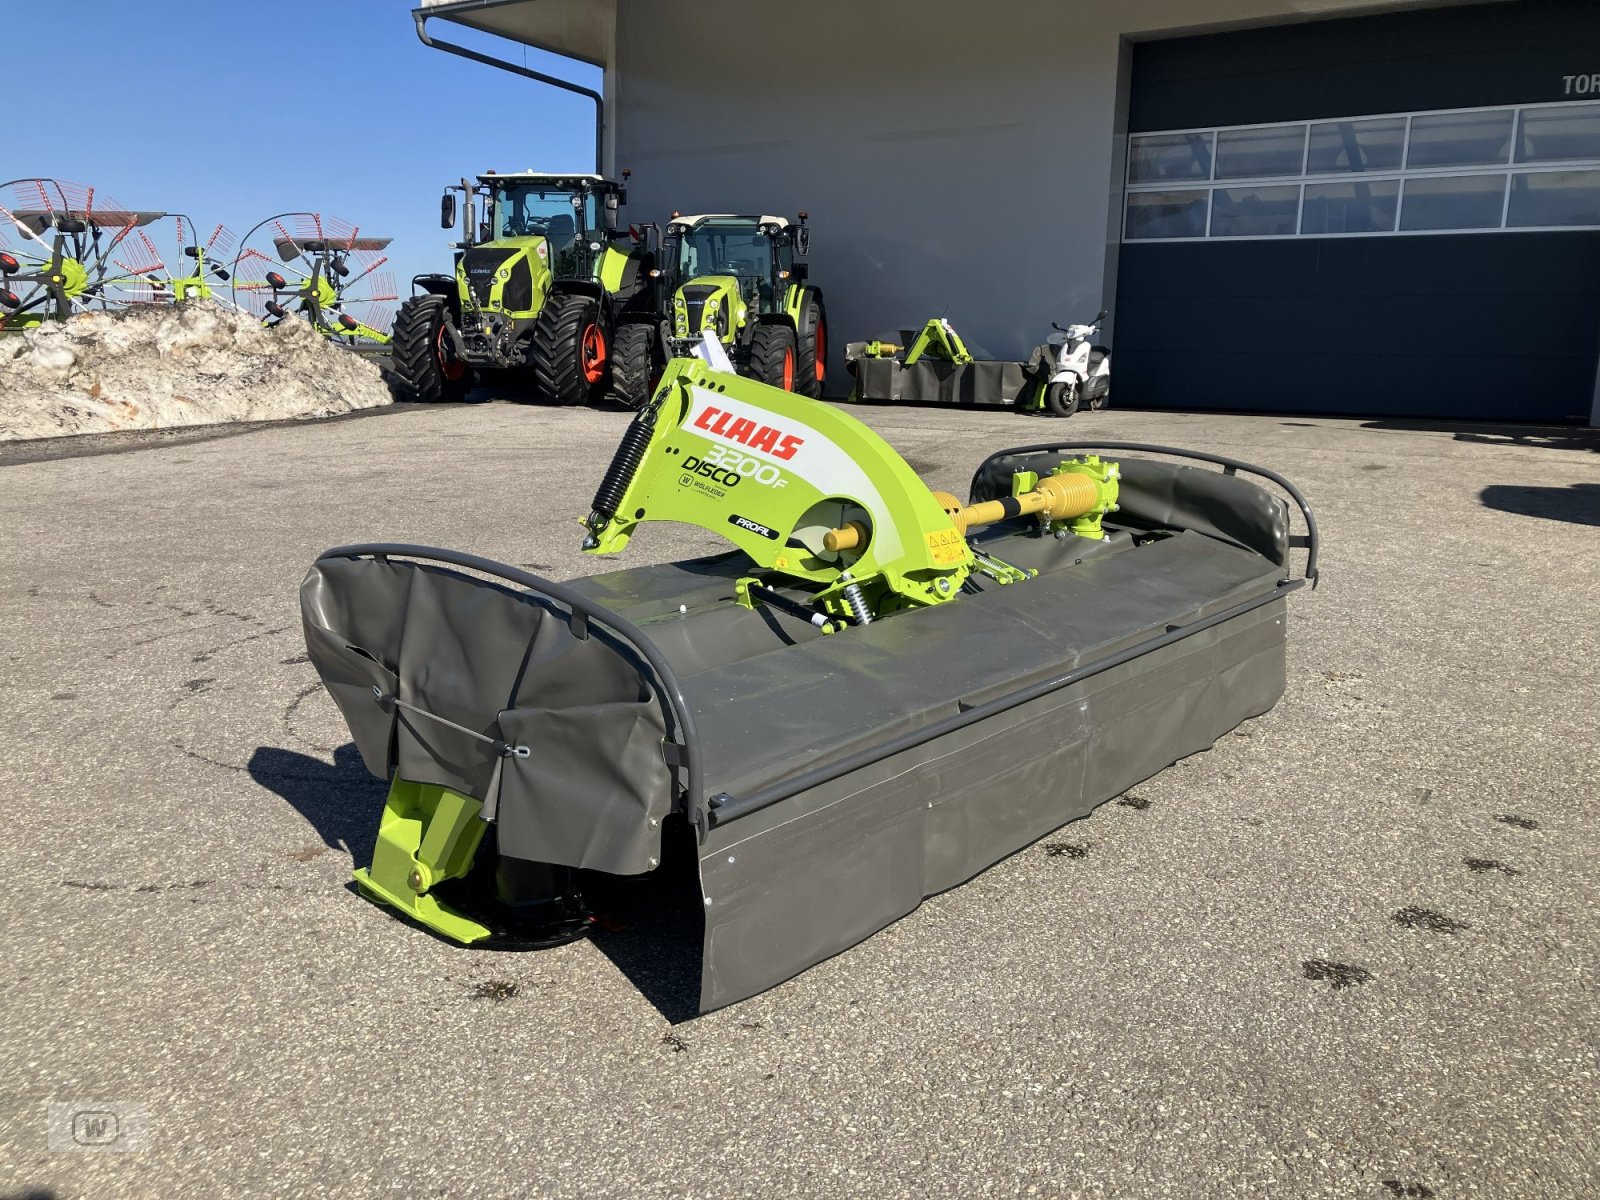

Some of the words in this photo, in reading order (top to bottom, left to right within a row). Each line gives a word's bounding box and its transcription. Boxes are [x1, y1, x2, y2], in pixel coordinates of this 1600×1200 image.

[1563, 73, 1600, 94] TOR
[694, 406, 804, 461] CLAAS
[681, 456, 741, 487] DISCO
[735, 517, 769, 537] PROFIL
